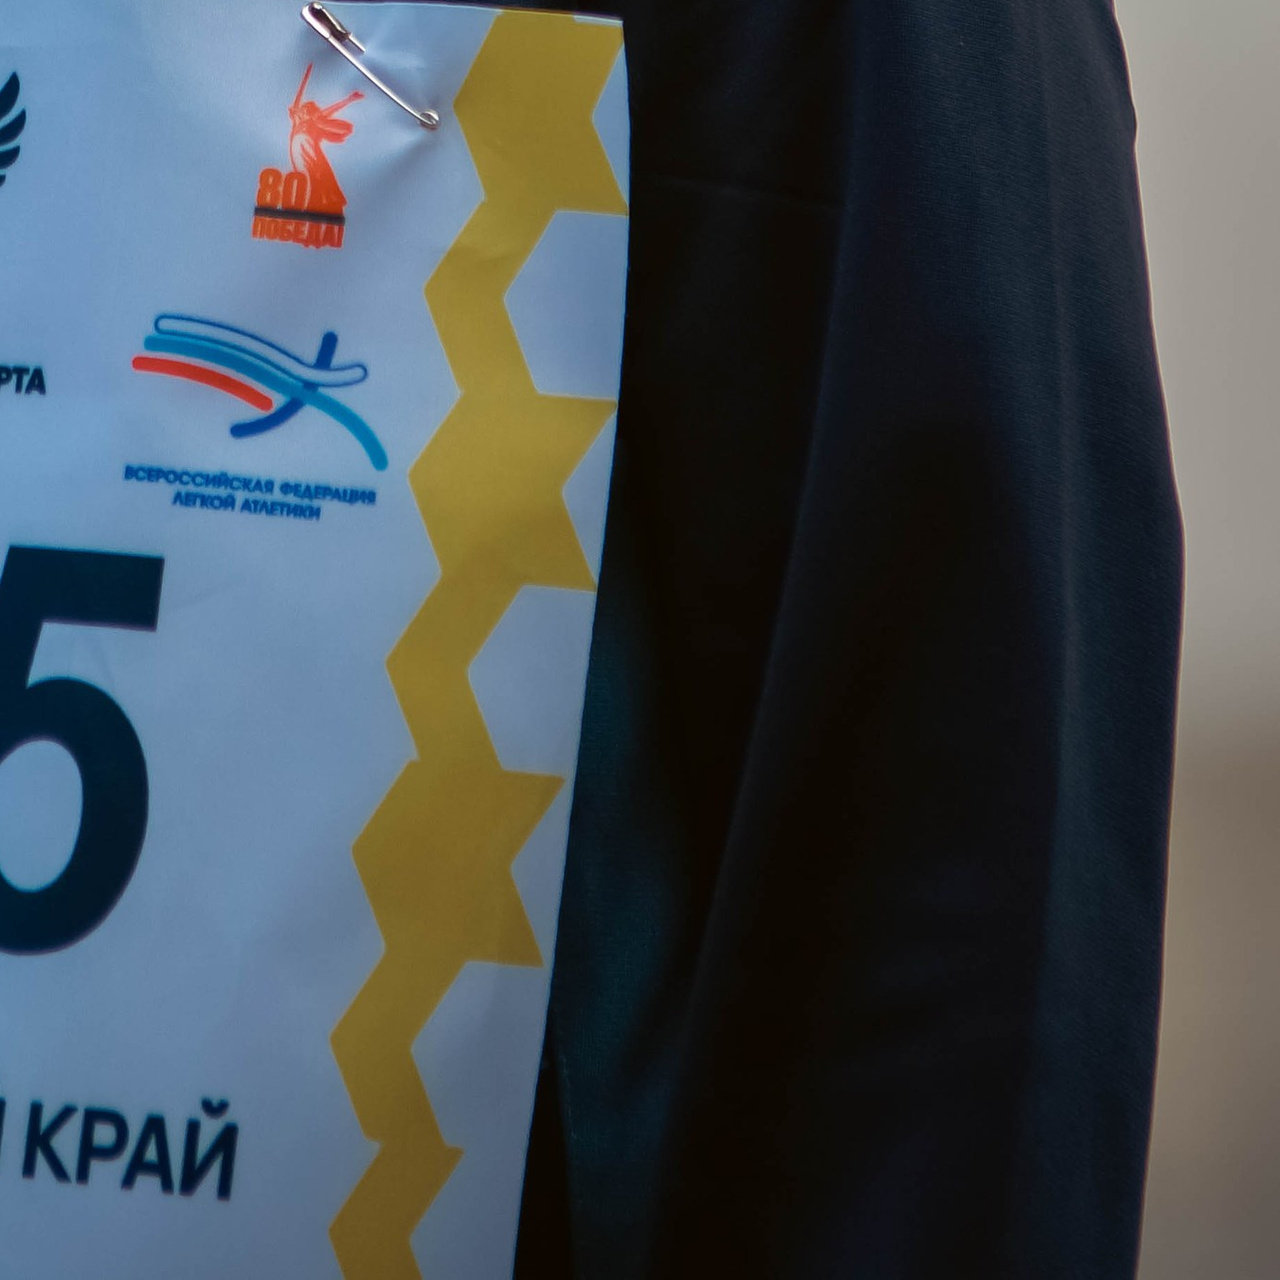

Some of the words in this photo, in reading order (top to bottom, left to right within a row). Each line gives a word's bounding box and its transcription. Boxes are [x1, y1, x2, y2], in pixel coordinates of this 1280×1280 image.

[257, 168, 310, 210] 80
[123, 465, 274, 495] ВСЕРОССИЙСКАЯ
[279, 482, 377, 505] ФЕДЕРАЦИЯ
[172, 491, 236, 512] ЛЕГКОЙ
[239, 497, 321, 521] АТЛЕТИКИ
[21, 1098, 239, 1202] КРАЙ
